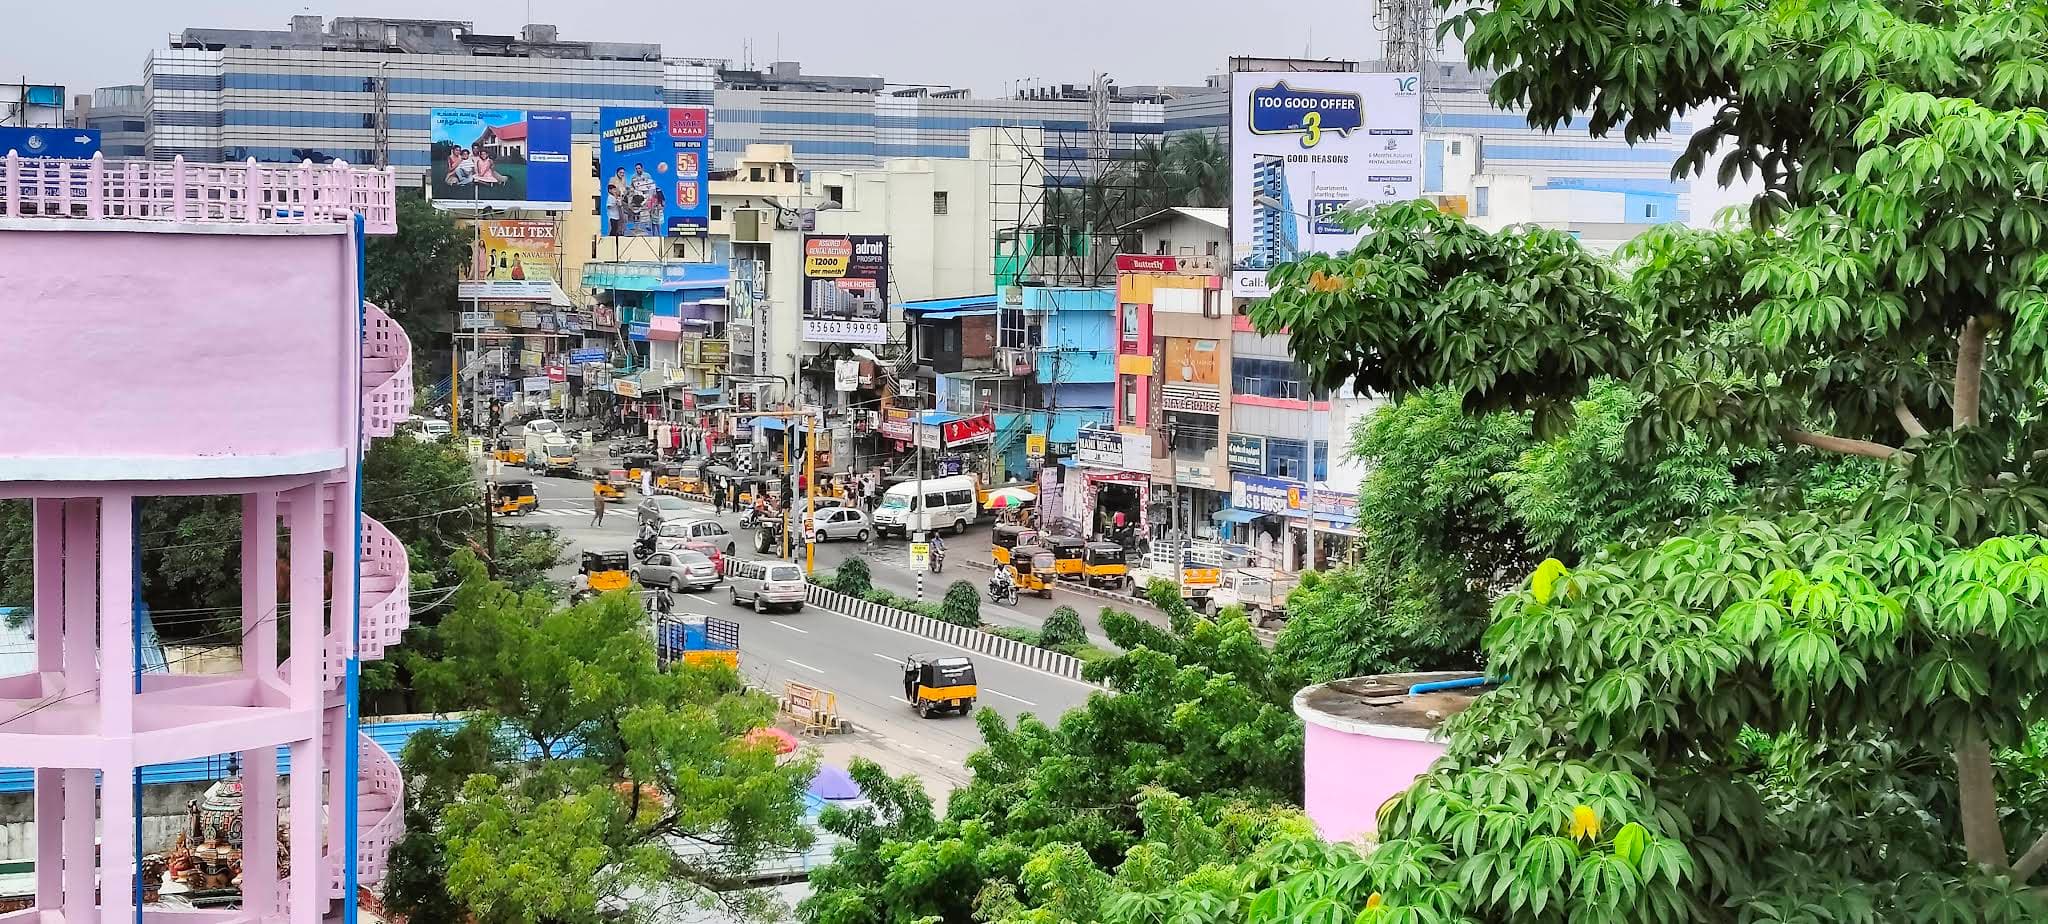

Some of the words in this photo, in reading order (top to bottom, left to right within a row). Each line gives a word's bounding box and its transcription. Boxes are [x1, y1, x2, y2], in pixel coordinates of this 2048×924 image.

[1258, 97, 1282, 108] TOO
[1285, 98, 1317, 109] GOOD
[1320, 98, 1355, 110] OFFER
[616, 115, 646, 128] INDIA'S
[673, 120, 701, 128] SMART
[603, 125, 624, 139] NEW
[624, 121, 658, 134] SAVINGS
[672, 127, 702, 135] BAZAAR
[1302, 111, 1321, 148] 3
[614, 131, 648, 145] BAZAAR
[614, 143, 624, 153] IS
[624, 139, 647, 152] HERE!
[1287, 154, 1308, 164] GOOD
[1311, 155, 1349, 165] REASONS
[490, 226, 525, 238] VALLI
[528, 226, 555, 238] TEX
[855, 238, 884, 255] adroit
[815, 258, 839, 266] 12000
[1133, 260, 1163, 270] Butterfly
[1240, 273, 1265, 287] Call:
[810, 321, 841, 333] 95662
[846, 323, 879, 335] 99999
[1097, 440, 1122, 453] METALS
